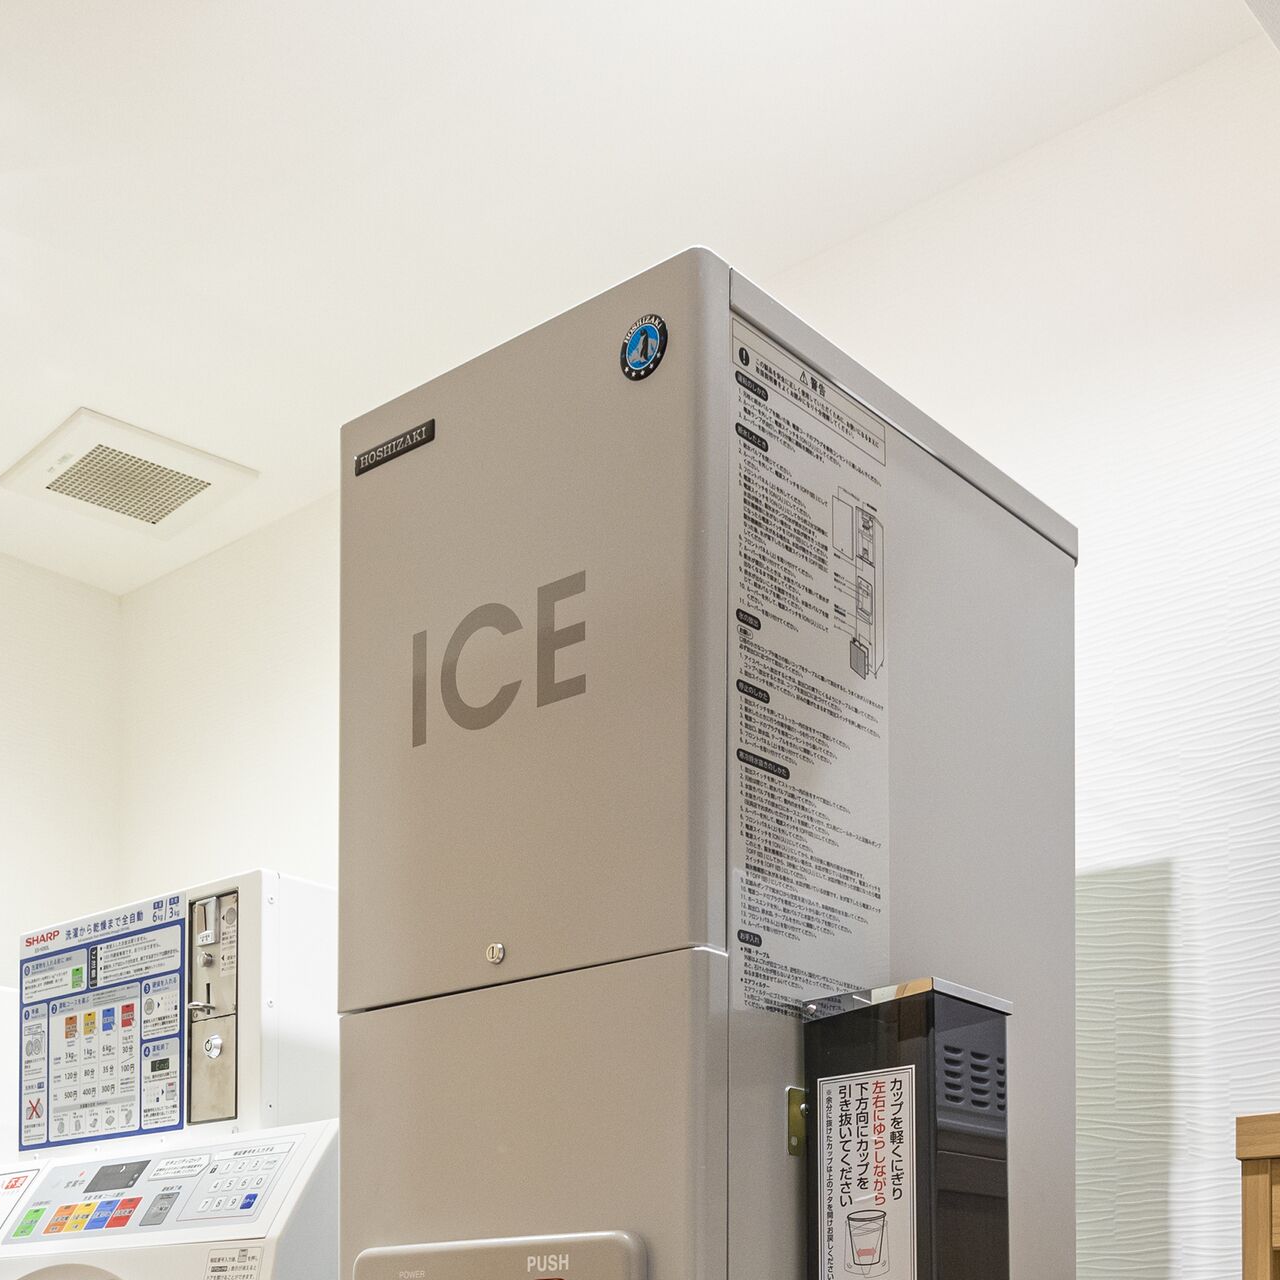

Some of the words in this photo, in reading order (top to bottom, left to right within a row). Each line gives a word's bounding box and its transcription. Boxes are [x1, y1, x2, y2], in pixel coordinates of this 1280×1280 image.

[359, 427, 427, 470] HOSHIZAKI
[412, 570, 586, 748] ICE
[26, 930, 60, 947] SHARP
[838, 1086, 854, 1207] 引き抜いてください
[855, 1082, 870, 1190] 下方向にカップを
[872, 1080, 886, 1206] 左右にゆらしながら
[890, 1077, 903, 1201] カップを軽くにぎり
[399, 1270, 426, 1280] POWER
[526, 1254, 569, 1272] PUSH
